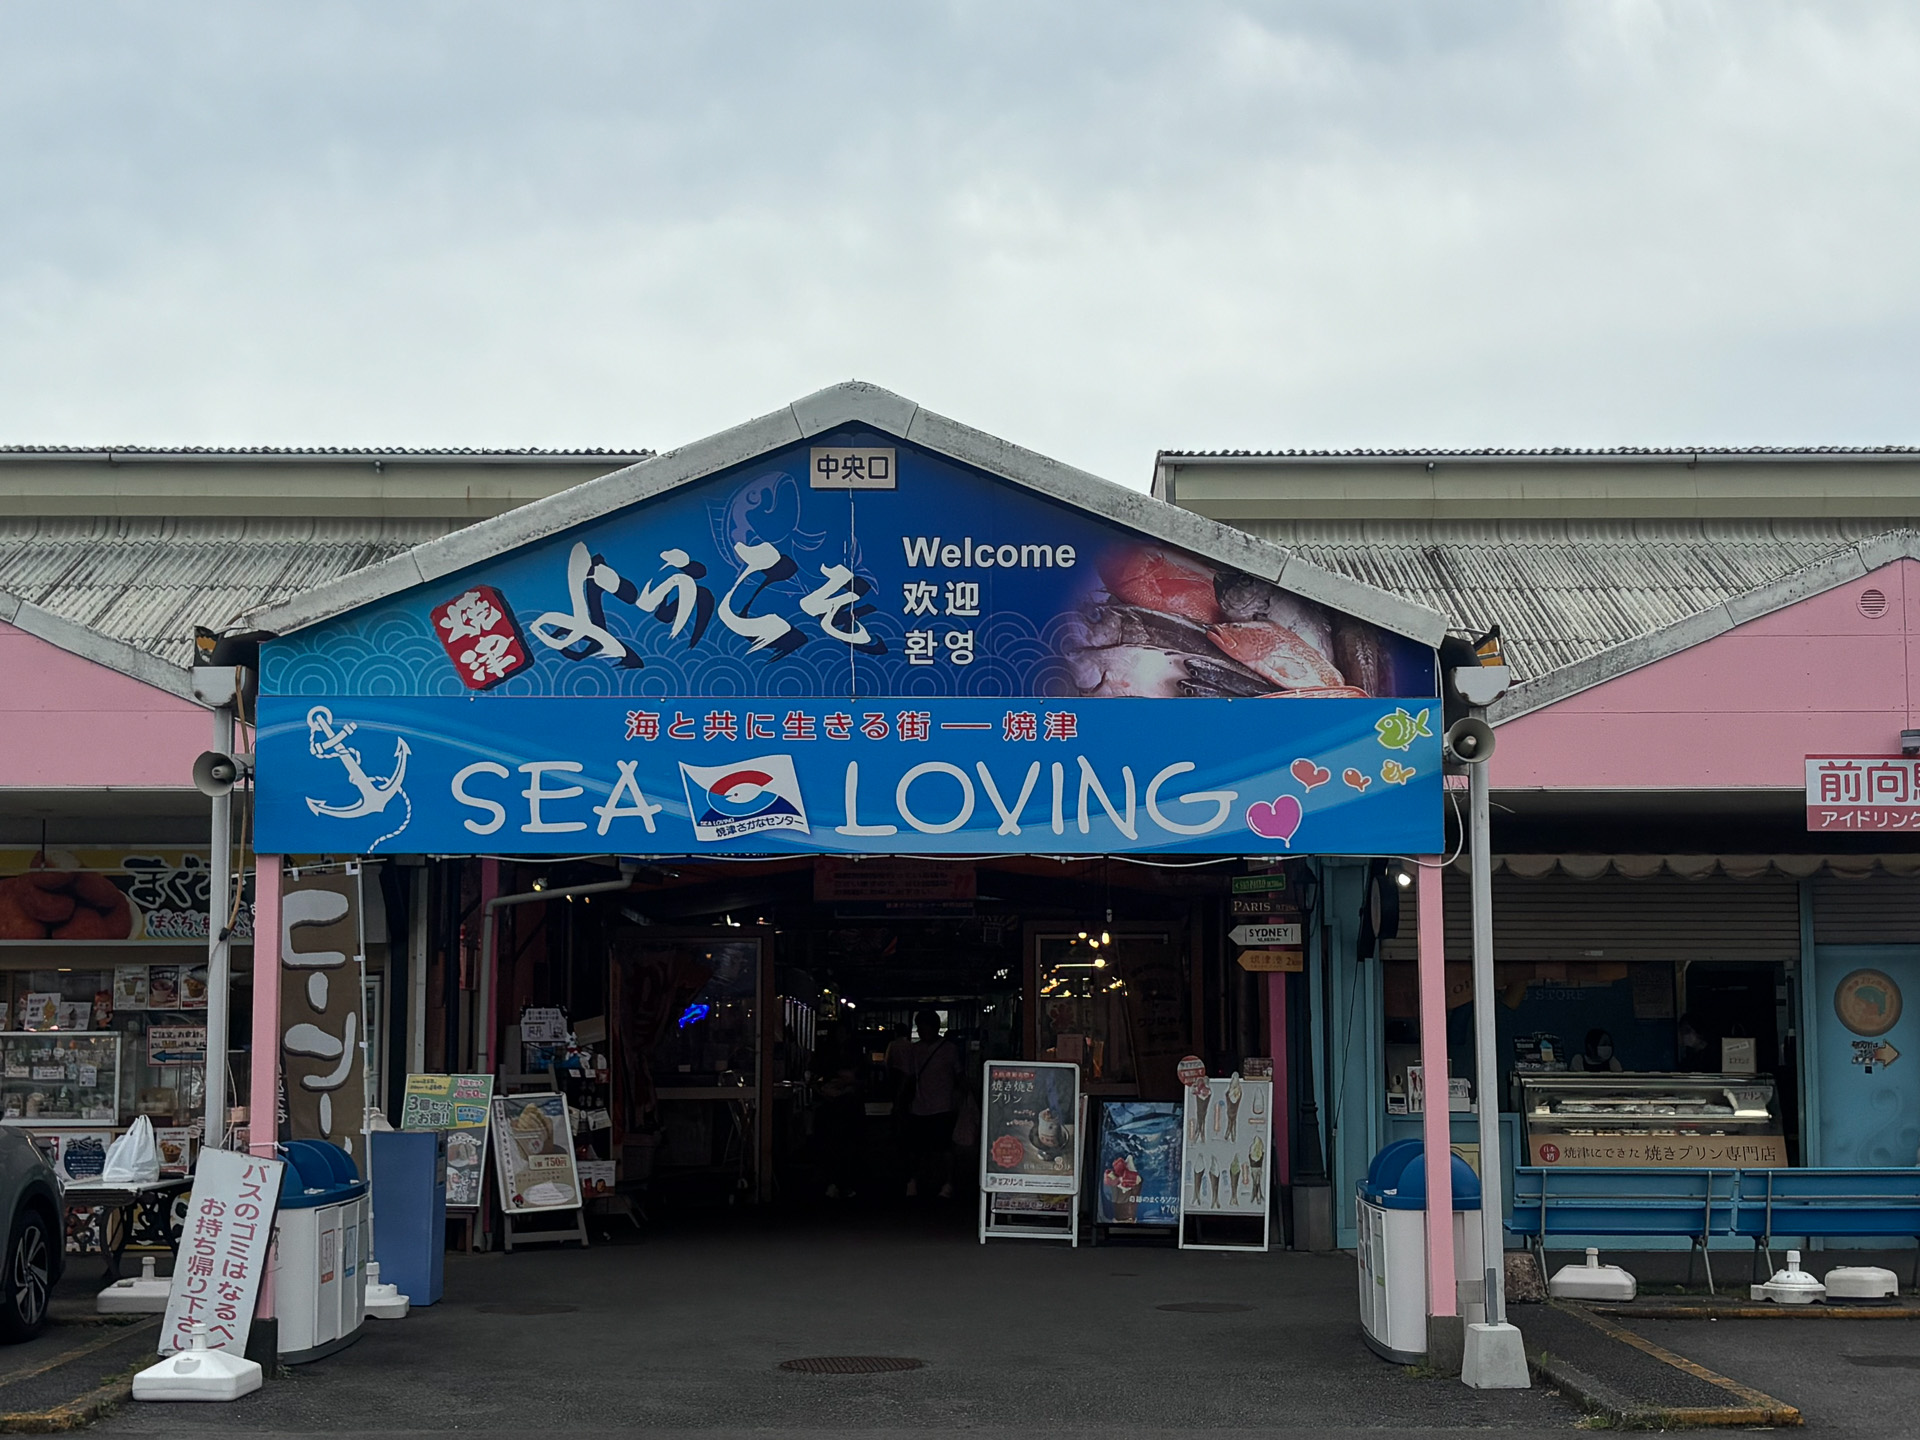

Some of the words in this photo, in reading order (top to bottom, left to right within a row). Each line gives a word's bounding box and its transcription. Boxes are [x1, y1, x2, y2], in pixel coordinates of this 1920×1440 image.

[816, 453, 891, 481] 中央口
[902, 536, 1077, 568] Welcome
[529, 540, 876, 661] ようこそ
[903, 580, 981, 619] 欢迎
[437, 588, 518, 683] 焼津
[904, 631, 976, 666] 환영
[1818, 760, 1920, 803] 前向
[451, 759, 662, 835] SEA
[836, 757, 1239, 839] LOVING
[715, 815, 805, 838] 焼津さかなセンター
[1233, 900, 1271, 912] PARIS
[1249, 928, 1289, 937] SYDNEY
[1535, 988, 1586, 1001] STORE
[991, 1080, 1034, 1092] 焼き焼き
[992, 1092, 1023, 1105] プリン
[407, 1095, 454, 1111] 3個セット
[1563, 1145, 1640, 1160] 焼津にできた
[1644, 1144, 1777, 1163] 焼きプリン専門店
